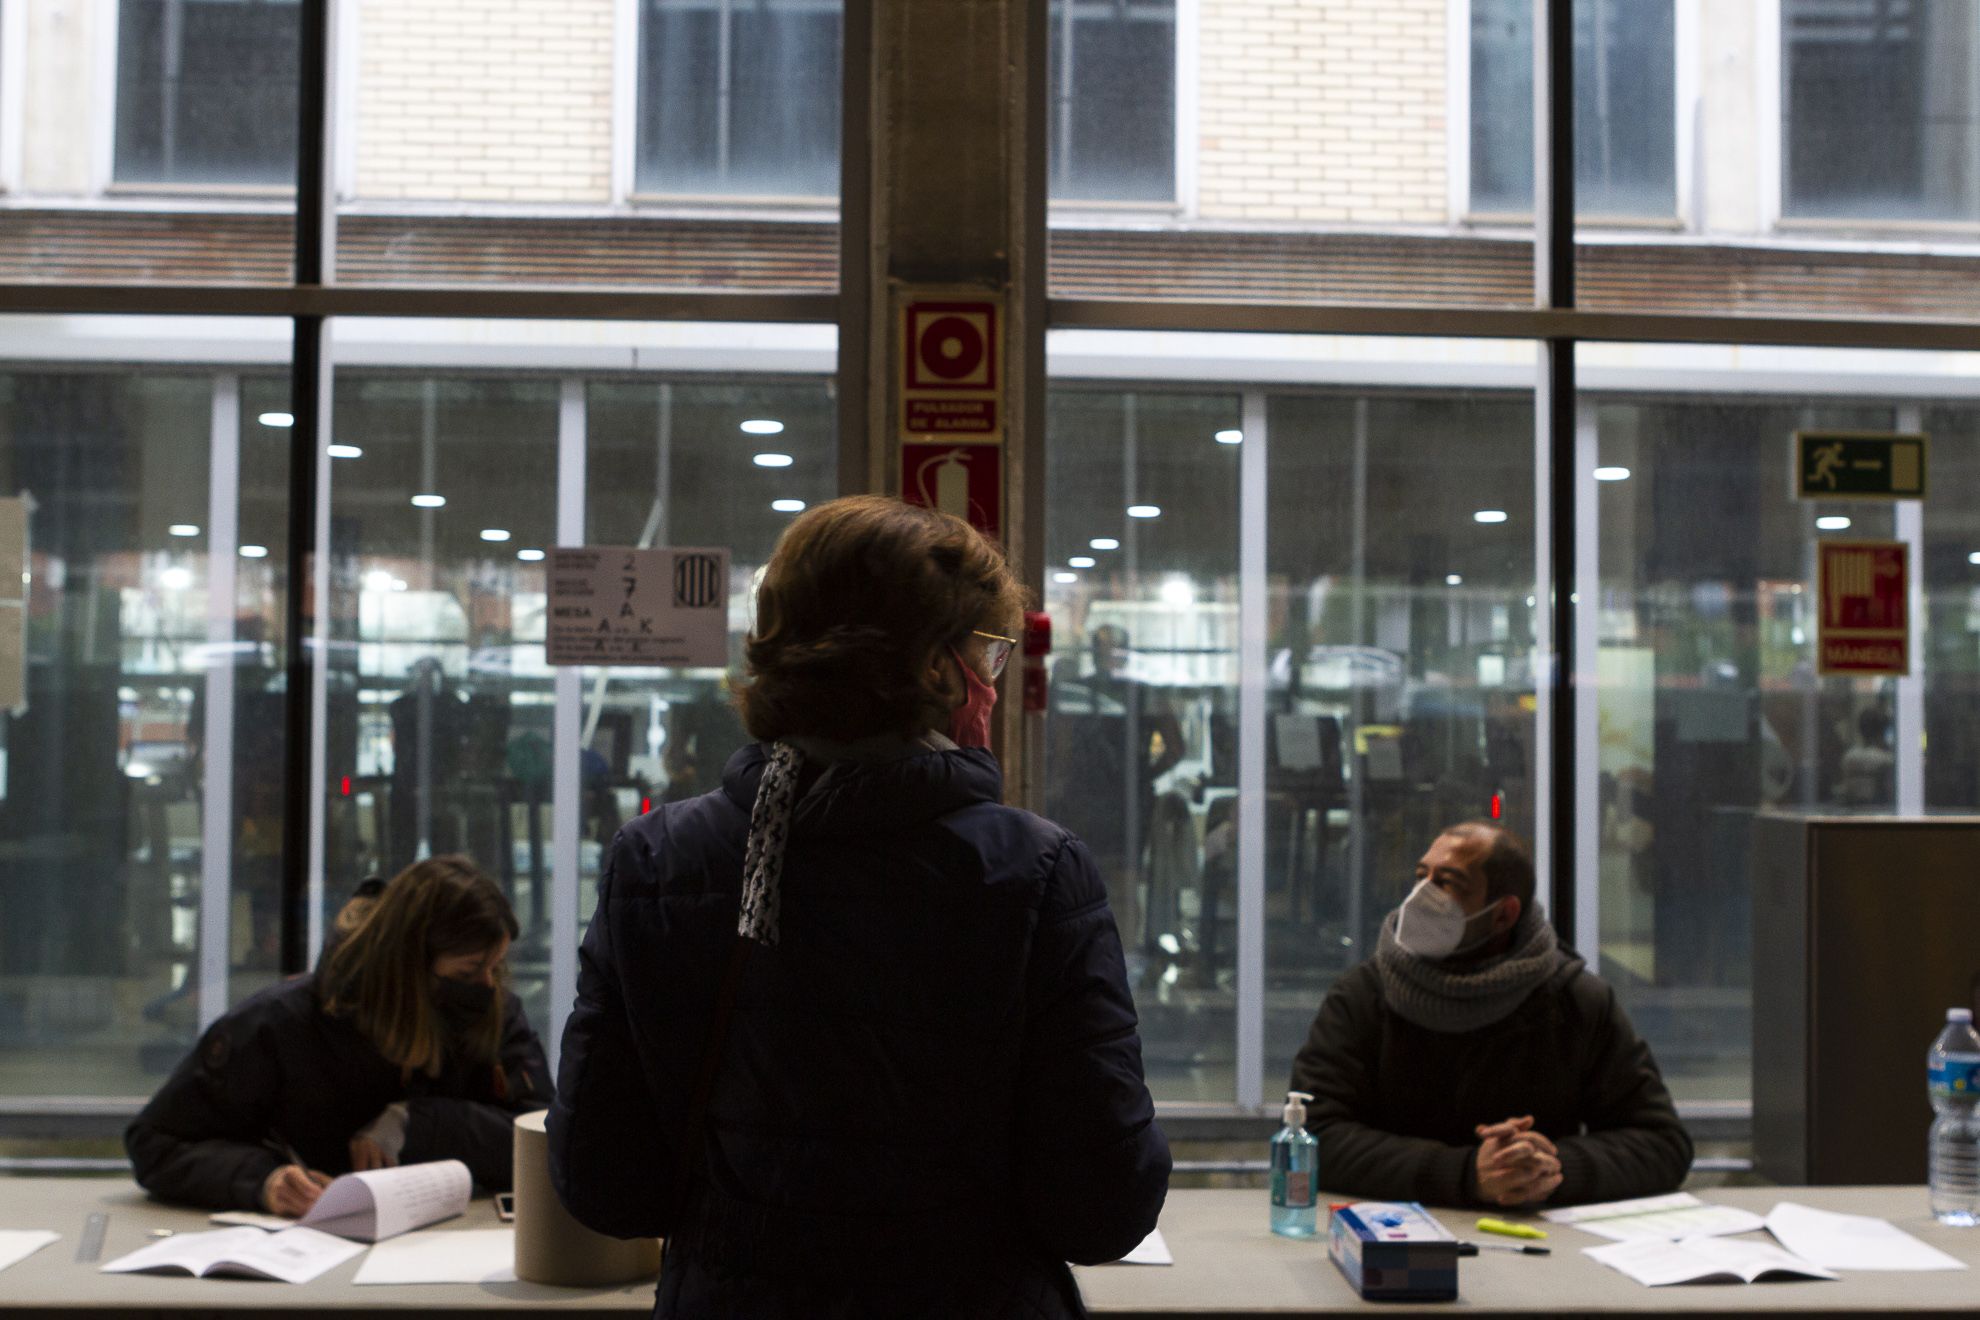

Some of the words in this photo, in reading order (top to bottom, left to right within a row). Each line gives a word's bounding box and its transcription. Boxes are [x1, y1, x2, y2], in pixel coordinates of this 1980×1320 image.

[909, 417, 928, 429] DE
[934, 417, 990, 429] ALARMA
[623, 553, 636, 570] 2
[622, 577, 636, 598] 7
[554, 606, 592, 618] MESA
[620, 602, 634, 617] A
[597, 618, 611, 632] A
[640, 618, 653, 634] K
